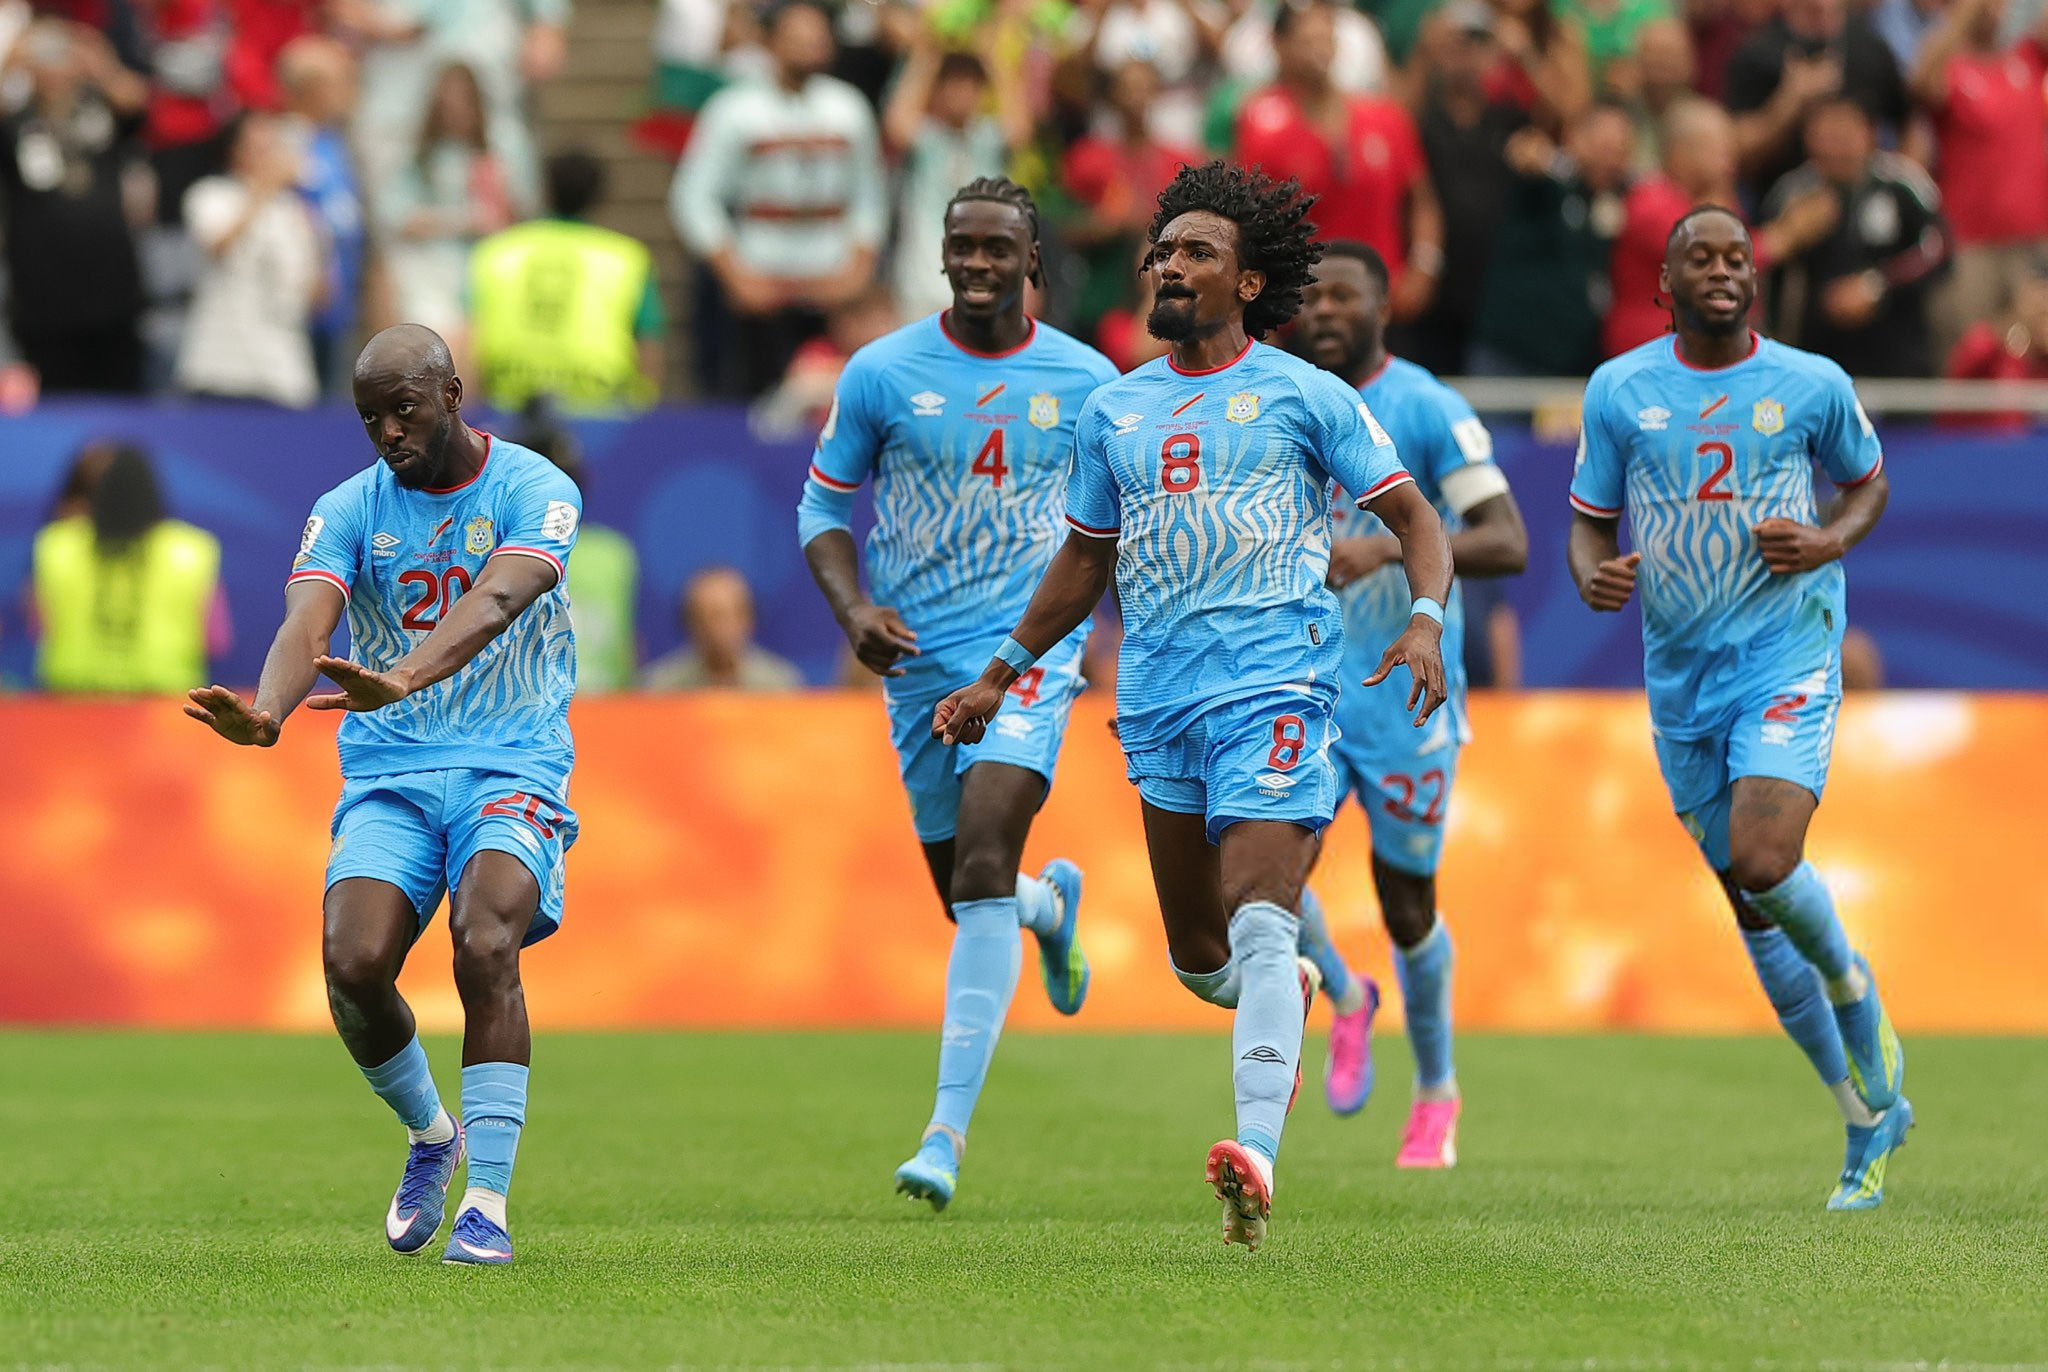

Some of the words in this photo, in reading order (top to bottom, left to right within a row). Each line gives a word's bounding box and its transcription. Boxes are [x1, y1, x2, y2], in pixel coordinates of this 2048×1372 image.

[971, 429, 1009, 489] 4
[1161, 433, 1201, 494] 8
[1696, 441, 1734, 502] 2
[372, 549, 396, 557] mbro
[397, 565, 473, 632] 20
[1007, 666, 1046, 710] 4
[1763, 694, 1807, 722] 2
[1267, 714, 1306, 772] 8
[1258, 788, 1290, 798] umbro
[1383, 767, 1446, 826] 22
